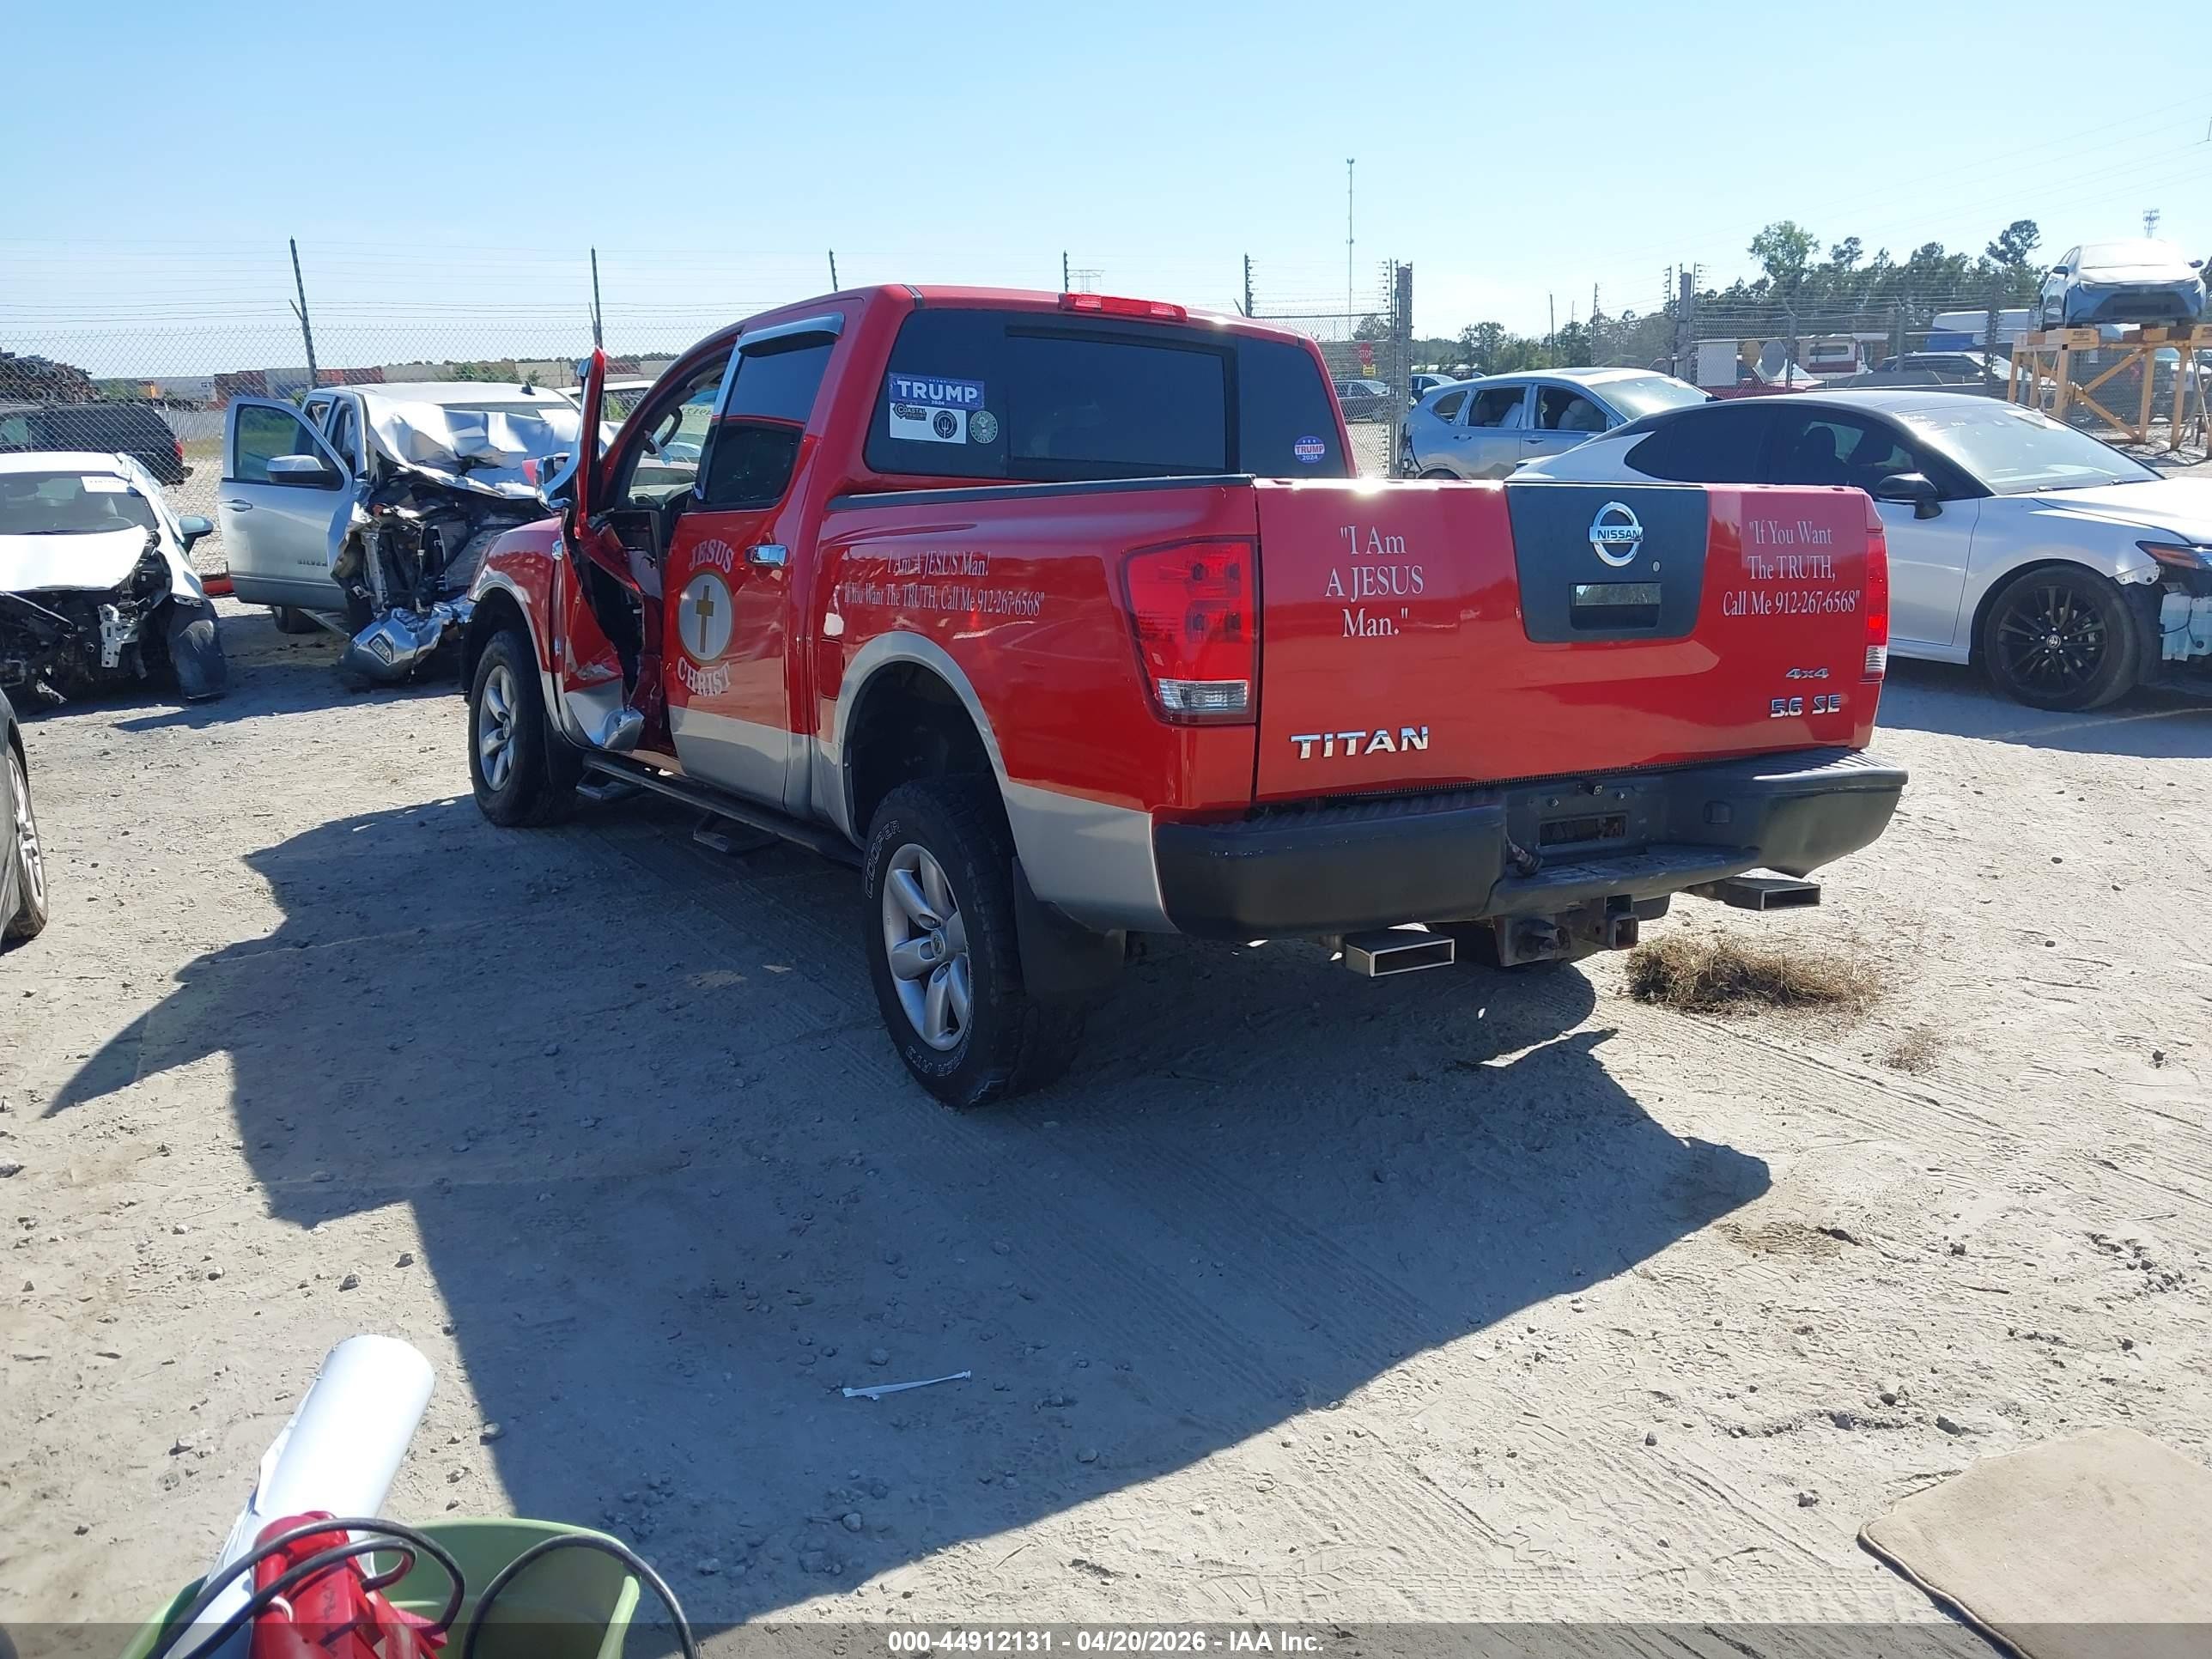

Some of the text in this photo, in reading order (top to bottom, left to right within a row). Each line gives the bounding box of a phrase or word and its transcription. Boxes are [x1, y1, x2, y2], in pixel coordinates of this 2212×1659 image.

[897, 380, 978, 403] TRUMP
[1340, 526, 1407, 555] "I Am
[1597, 529, 1641, 540] NISSAN
[1749, 520, 1832, 545] "If You Want
[688, 538, 735, 574] JESUS
[893, 551, 910, 574] Am
[922, 550, 958, 580] JESUS
[960, 550, 991, 576] Man!
[1747, 555, 1836, 584] The TRUTH,
[1325, 565, 1424, 603] A JESUS
[851, 582, 864, 604] You
[865, 582, 884, 605] Want
[885, 583, 901, 606] The
[902, 583, 939, 613] TRUTH,
[941, 585, 958, 611] Call
[961, 586, 975, 612] Me
[977, 589, 1045, 617] 912-267-6568"
[1723, 589, 1861, 617] Call Me 912-267-6568"
[1341, 607, 1409, 638] Man."
[677, 656, 731, 697] CHRIST
[1785, 668, 1829, 679] 4x4
[1770, 694, 1842, 718] 5.6 SE
[1290, 726, 1429, 760] TITAN
[865, 819, 901, 900] COOPER
